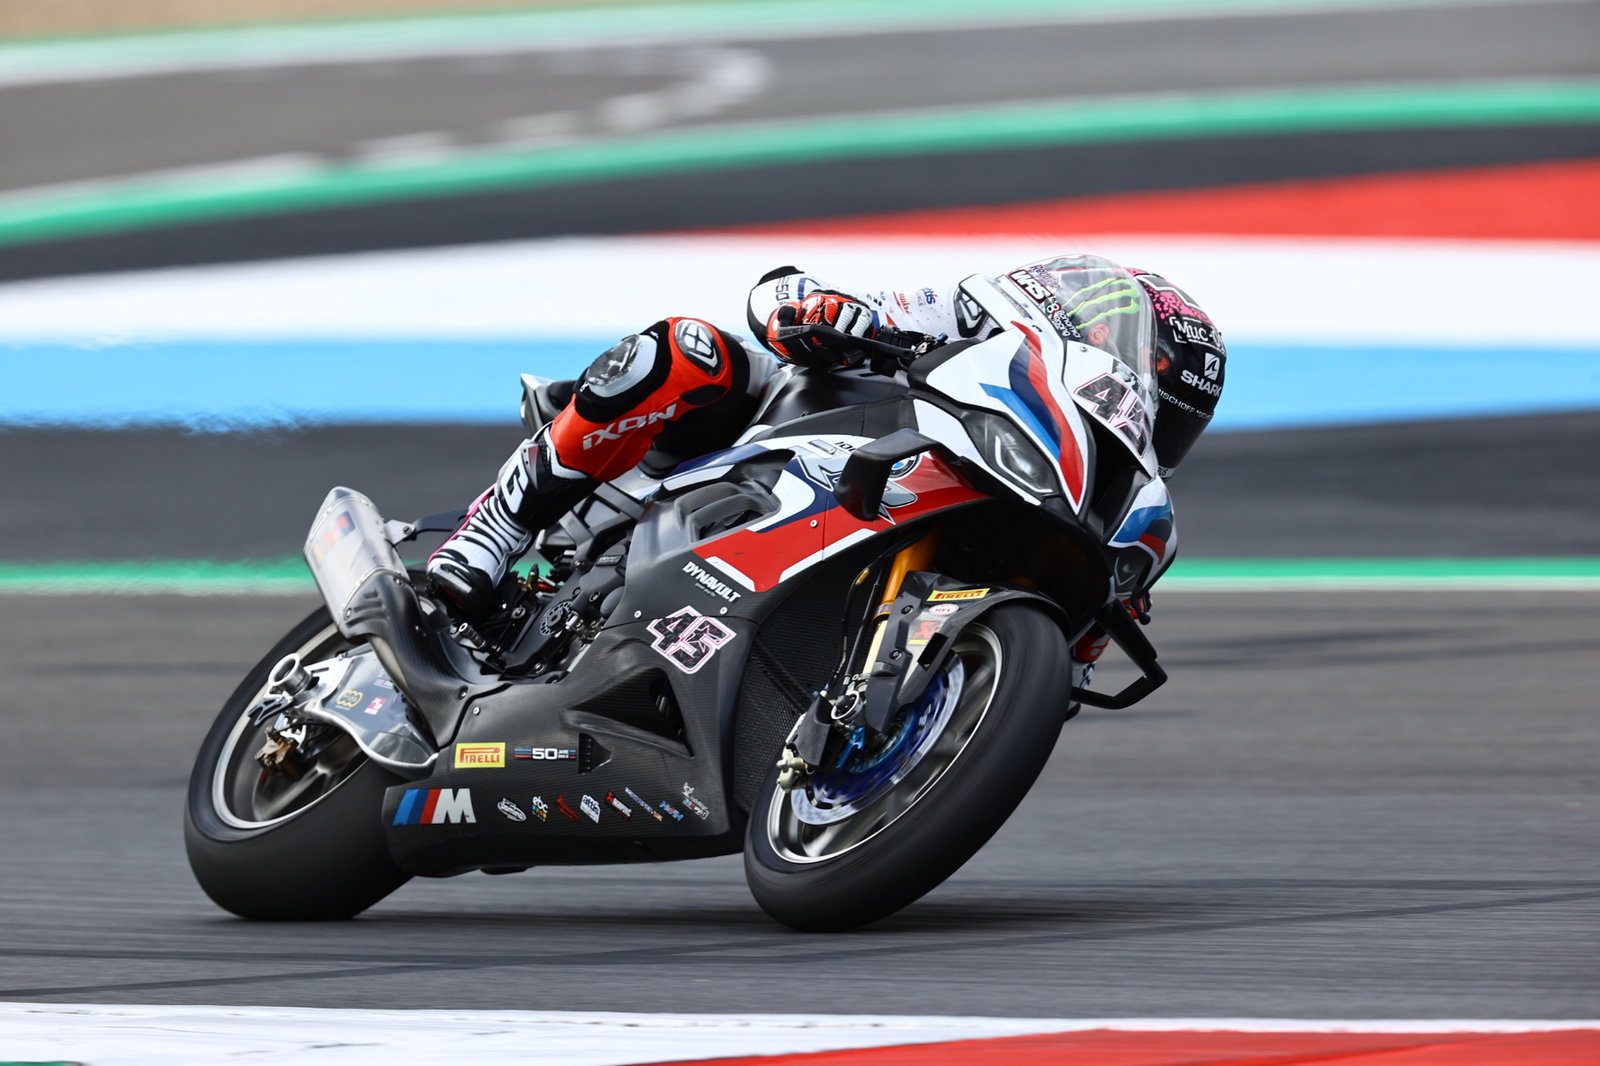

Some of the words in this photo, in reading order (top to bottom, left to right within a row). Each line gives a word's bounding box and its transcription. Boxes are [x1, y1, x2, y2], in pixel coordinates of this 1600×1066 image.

[1180, 369, 1222, 398] SHARK
[682, 561, 741, 602] DYNAVOLT
[934, 590, 983, 599] PIRELLI
[646, 605, 737, 674] 45
[460, 748, 500, 763] PIRELLI
[532, 748, 557, 760] 50
[431, 788, 476, 824] M
